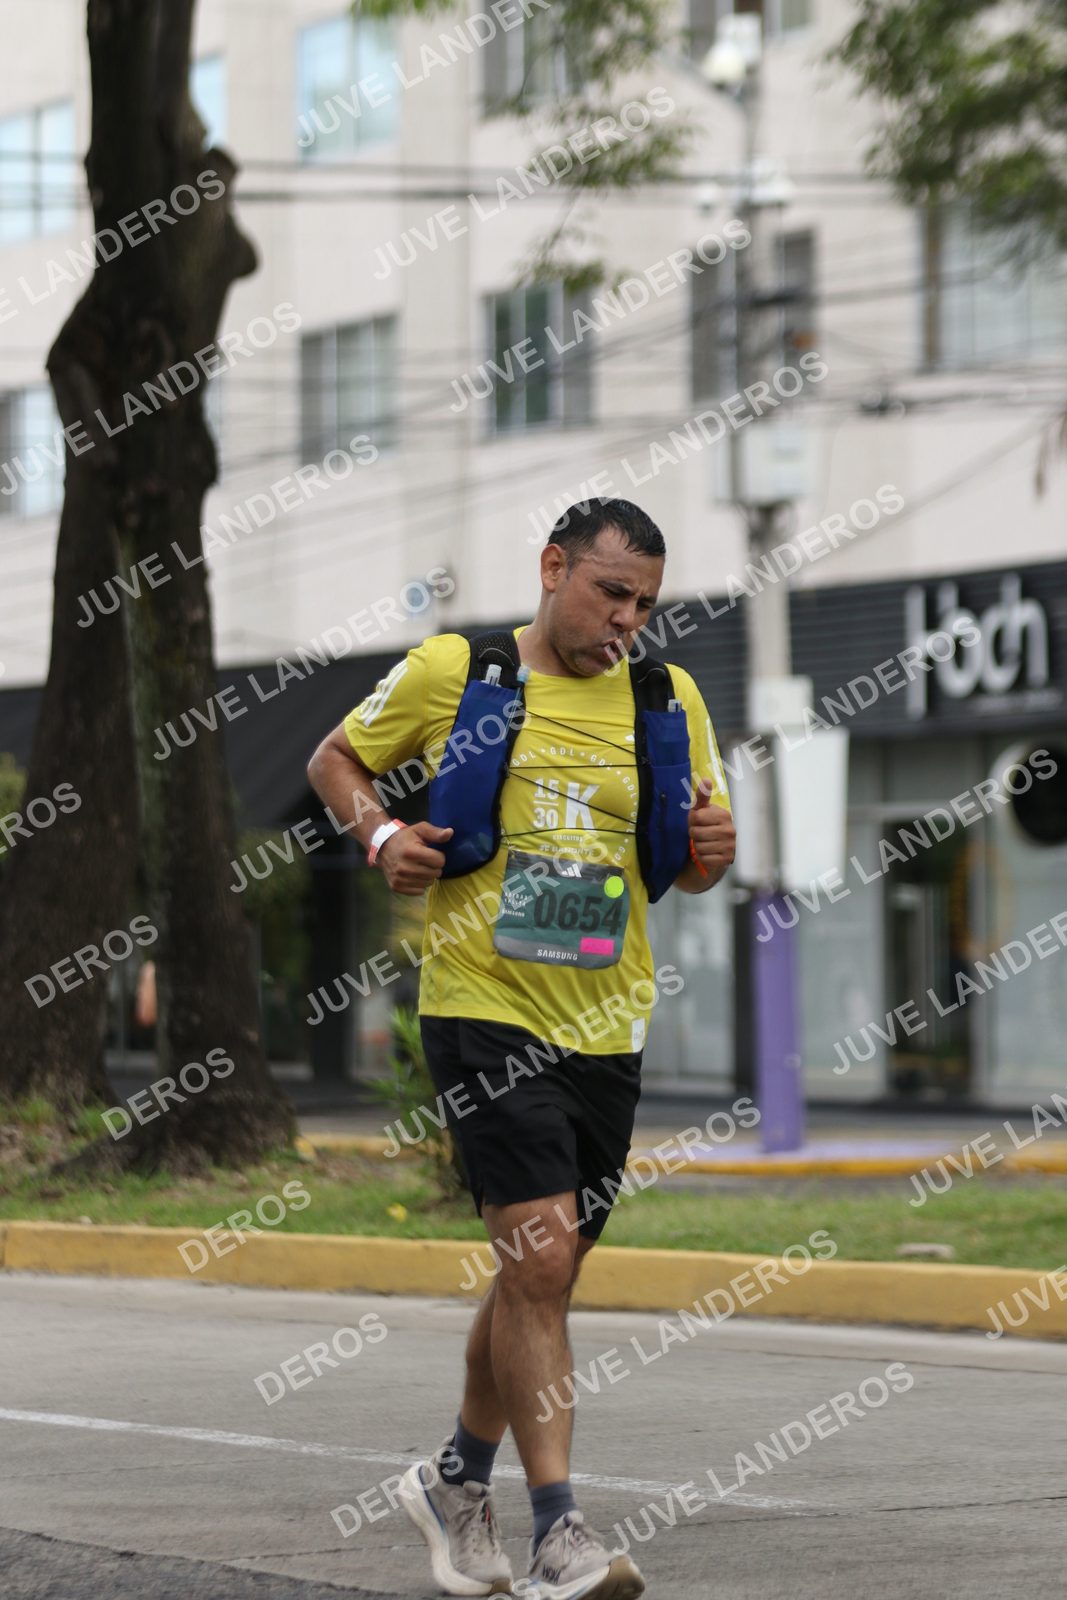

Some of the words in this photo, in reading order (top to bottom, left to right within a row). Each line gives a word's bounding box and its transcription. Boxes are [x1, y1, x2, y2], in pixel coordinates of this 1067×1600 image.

[534, 778, 559, 800] 15
[533, 807, 559, 829] 30
[565, 782, 600, 832] K
[534, 889, 624, 936] 0654
[537, 949, 578, 961] SAMSUNG
